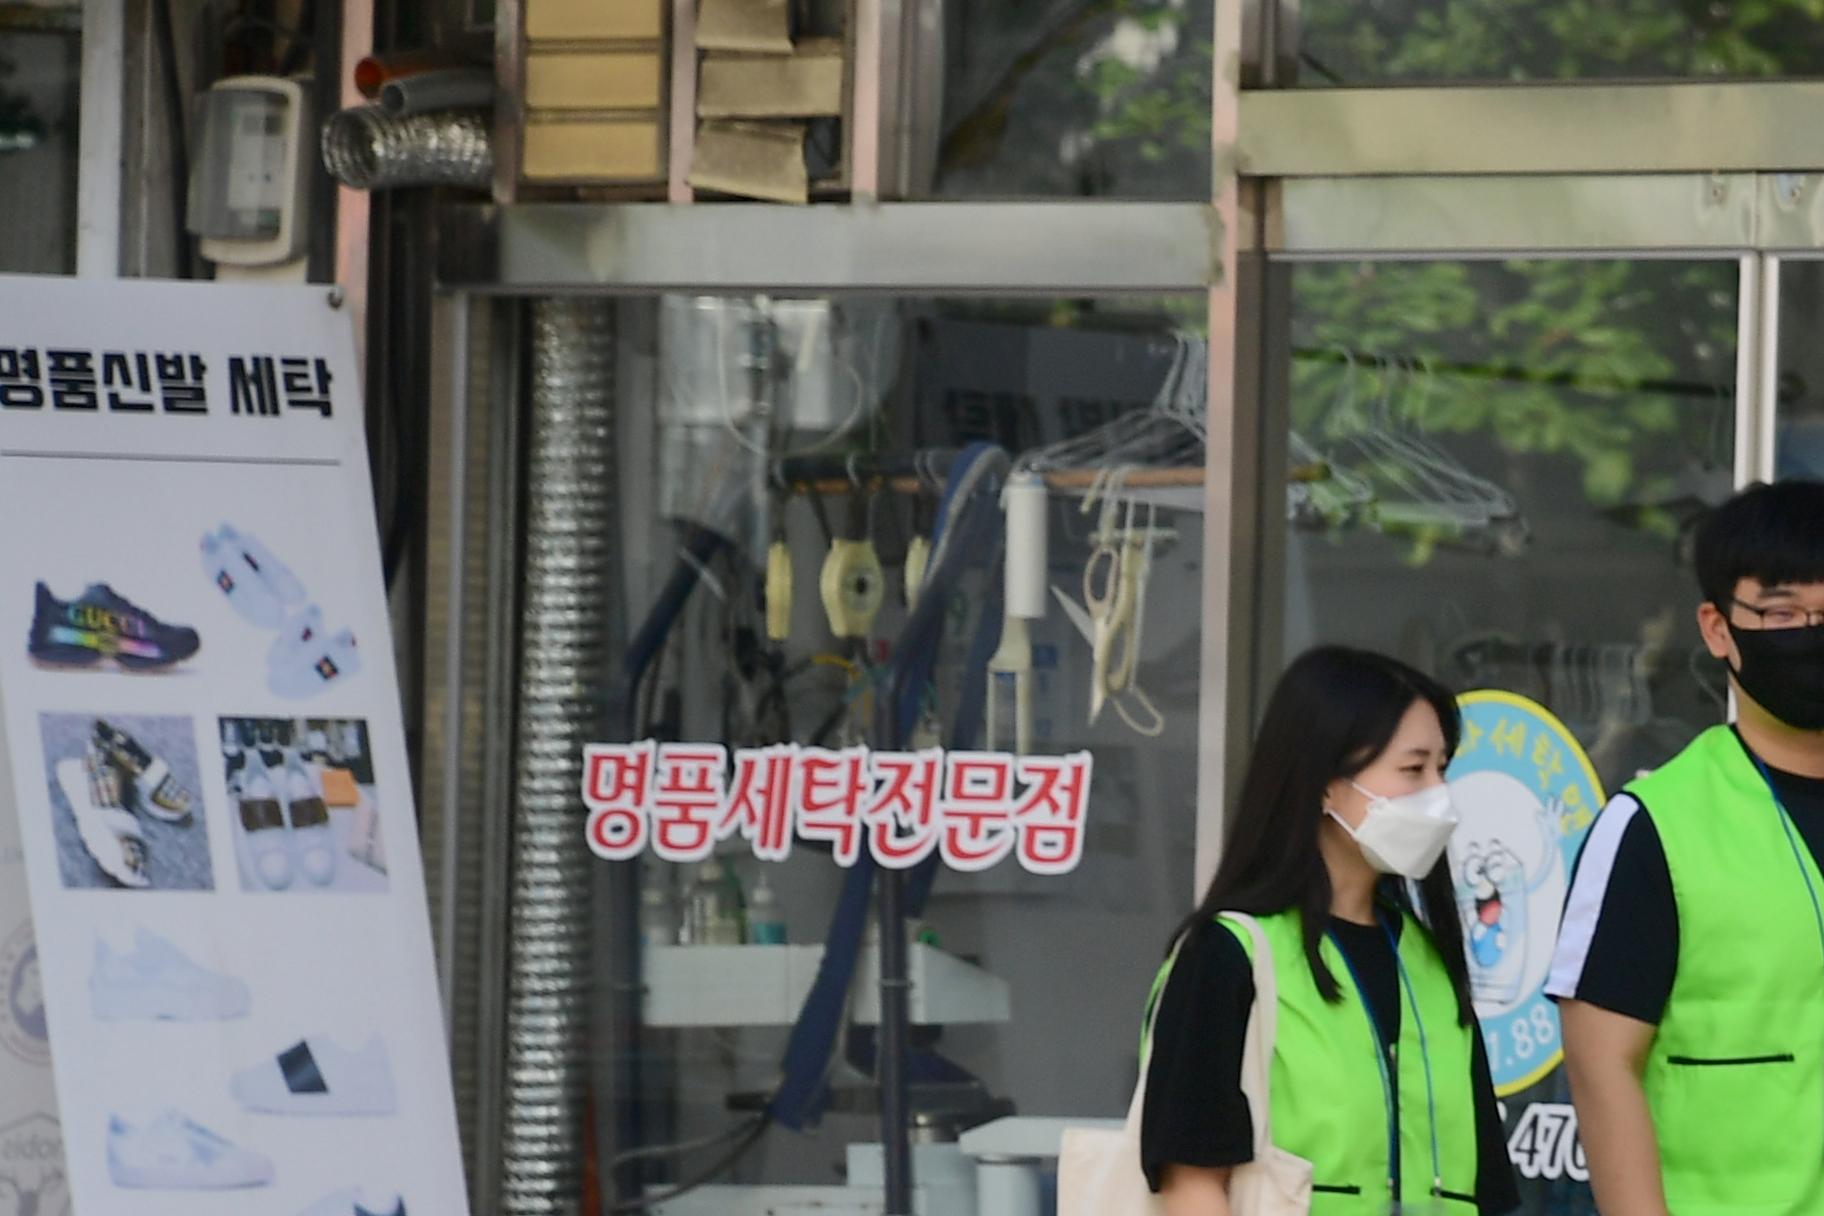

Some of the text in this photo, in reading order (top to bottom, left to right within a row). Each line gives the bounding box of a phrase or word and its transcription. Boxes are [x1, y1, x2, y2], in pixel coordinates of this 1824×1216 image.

[0, 345, 335, 419] 명품신발 세탁
[582, 739, 1094, 875] 명품세탁전문점
